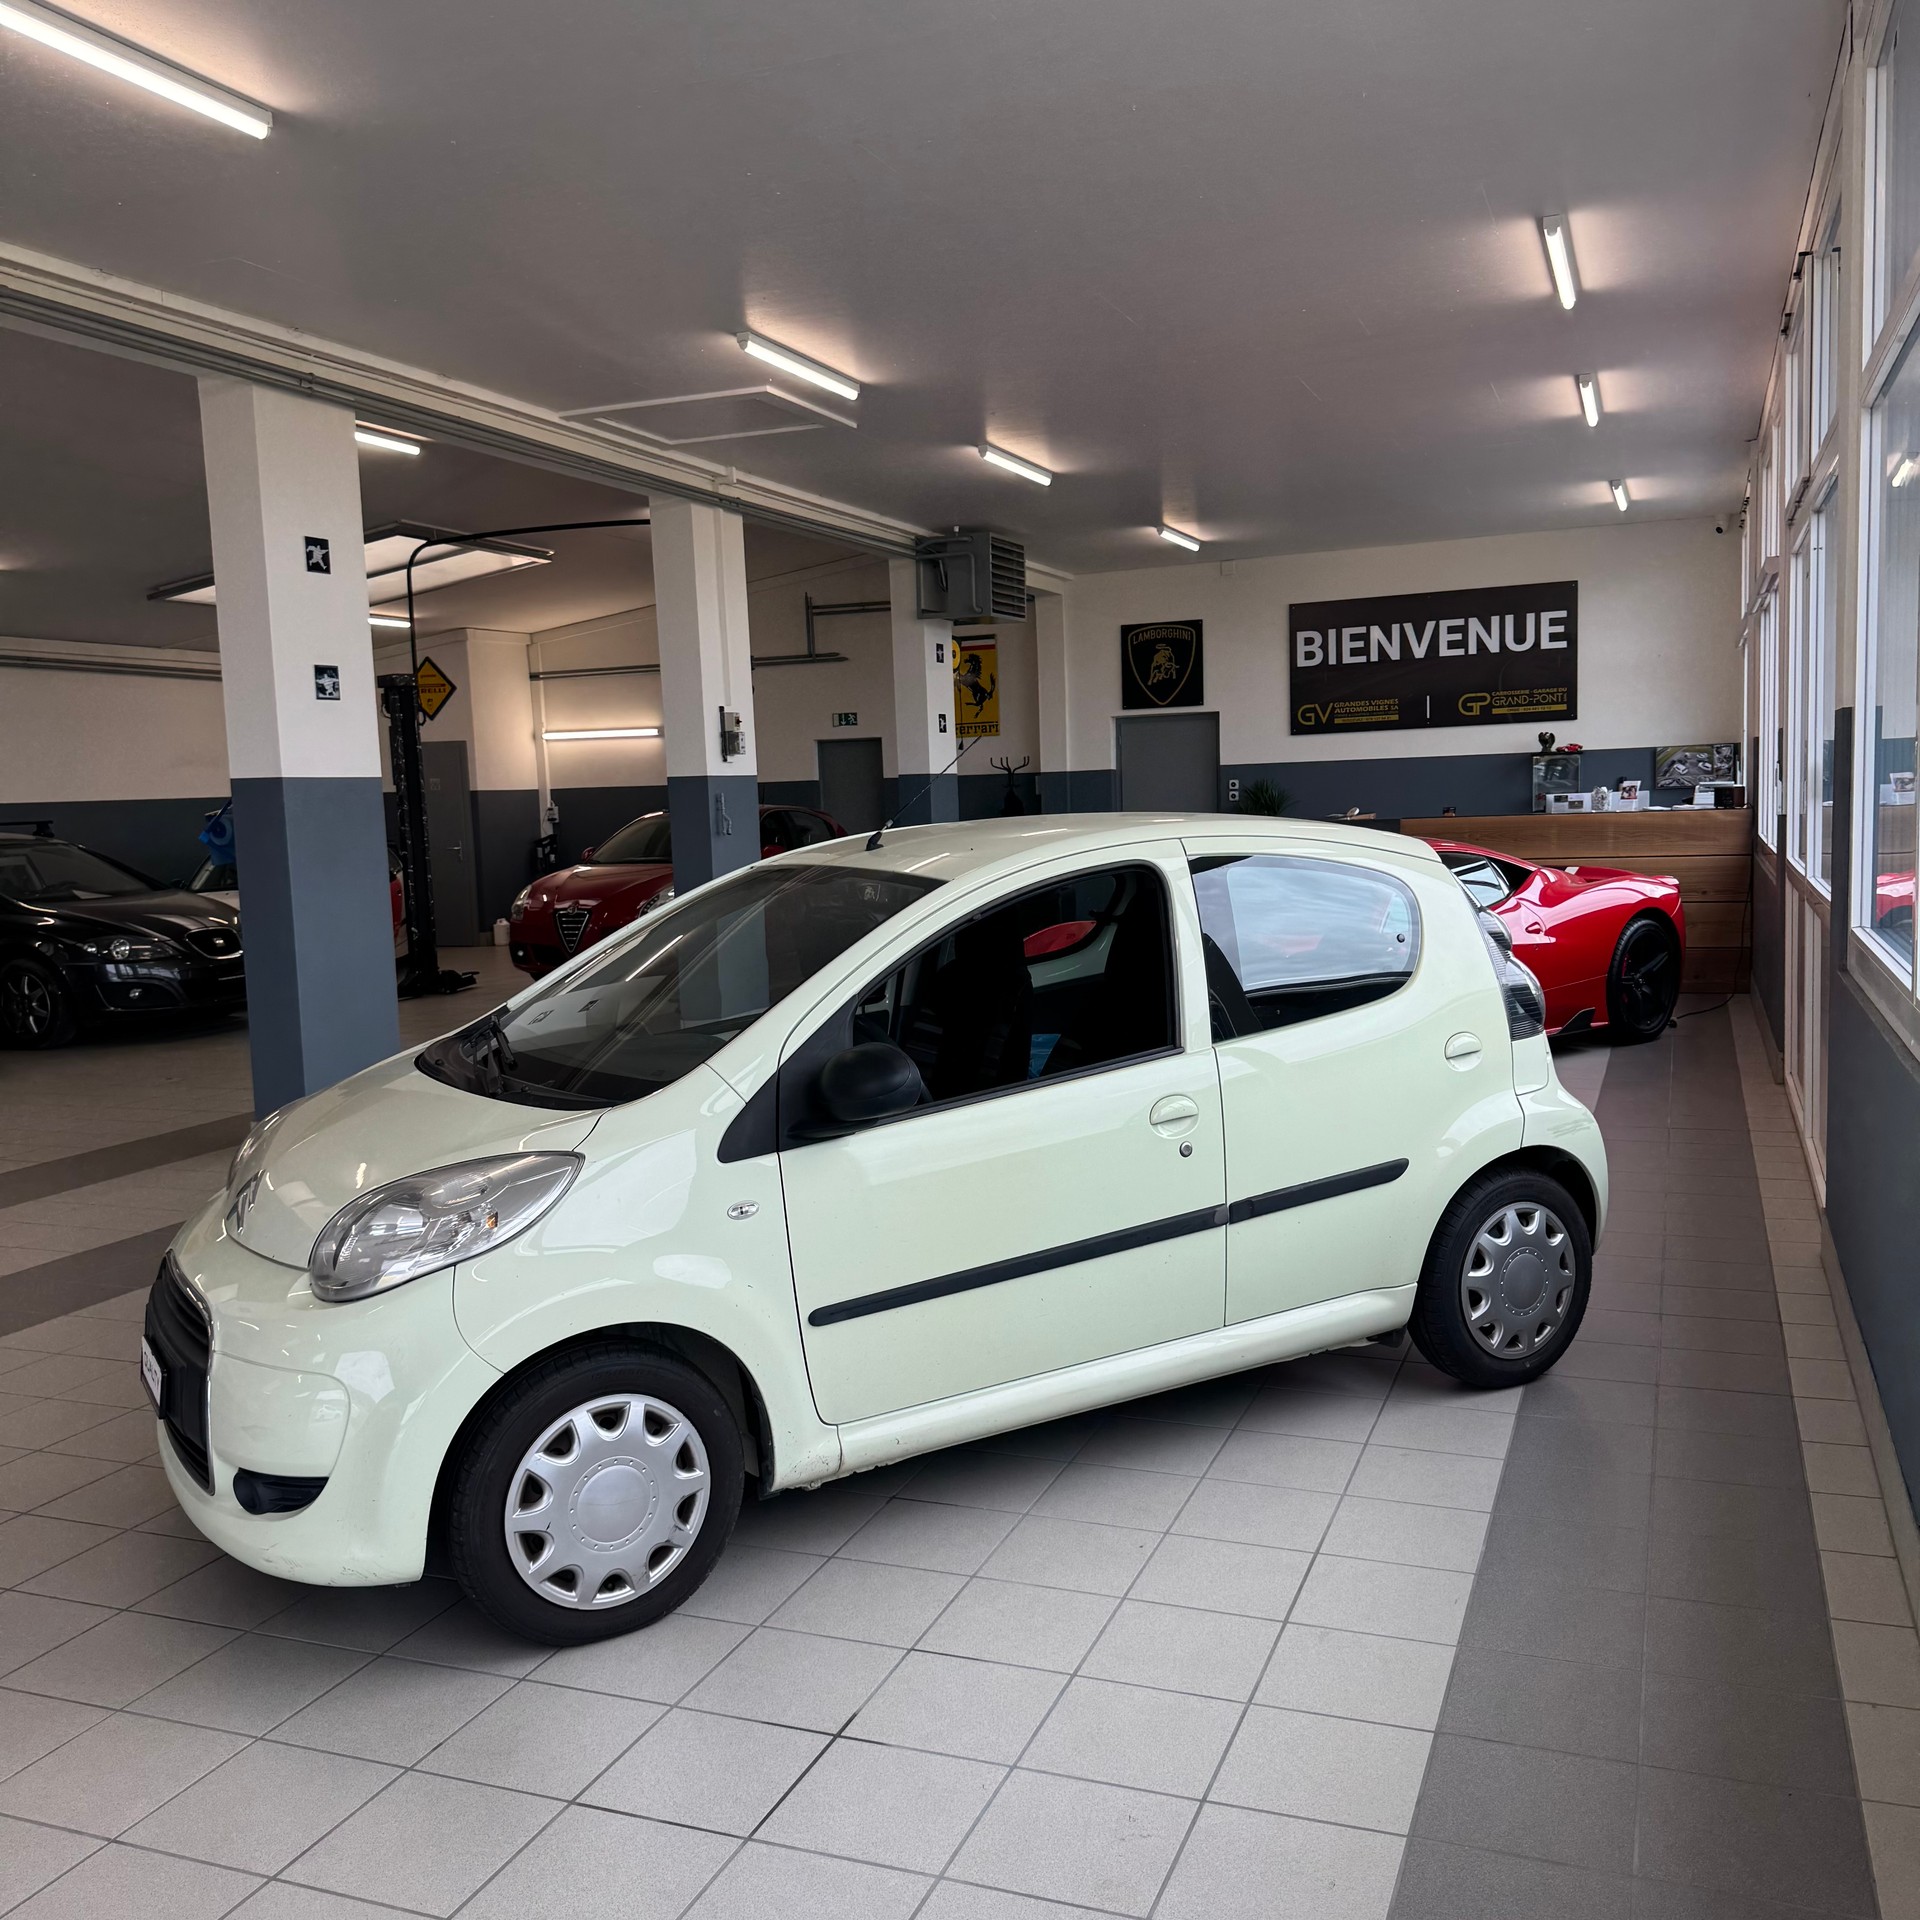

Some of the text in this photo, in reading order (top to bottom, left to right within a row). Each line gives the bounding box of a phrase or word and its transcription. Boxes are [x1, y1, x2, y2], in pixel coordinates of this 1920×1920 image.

[1133, 628, 1191, 644] LAMBORGHINI
[1296, 610, 1568, 668] BIENVENUE
[1491, 689, 1530, 697] CARROSSERIE
[1491, 692, 1562, 706] GRAND-PONT
[1334, 698, 1399, 708] GRANDES VIGNES
[1334, 705, 1389, 714] AUTOMOBILES
[1458, 693, 1491, 715] GP
[1298, 702, 1334, 725] GV
